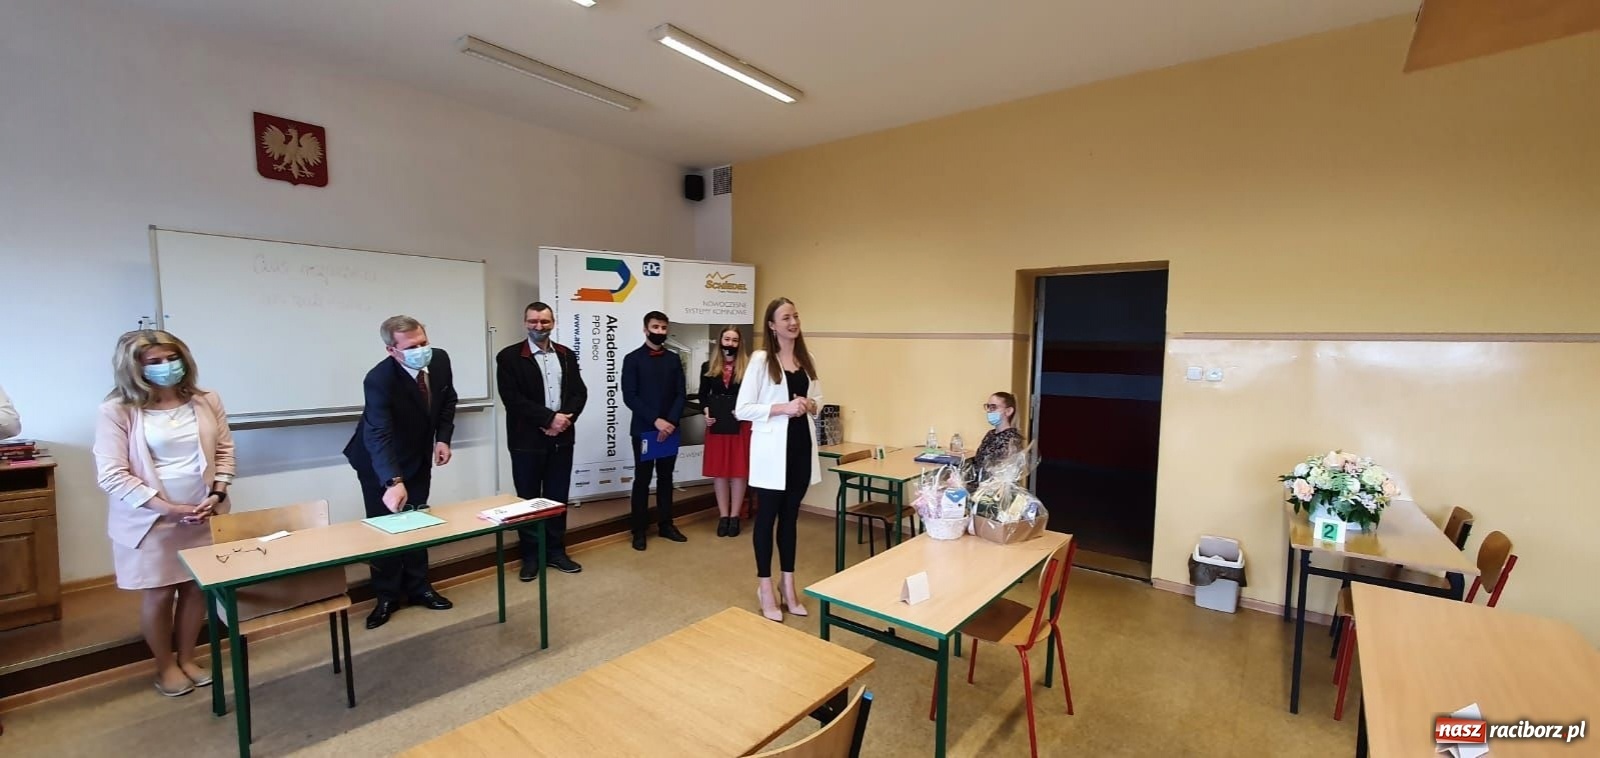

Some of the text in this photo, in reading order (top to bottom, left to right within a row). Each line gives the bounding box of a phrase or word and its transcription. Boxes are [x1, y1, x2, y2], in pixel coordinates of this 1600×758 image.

[642, 262, 660, 276] PPG
[702, 300, 747, 308] NOWOCZESNE
[684, 307, 748, 316] SYSTEMY KOMINOWE
[592, 315, 600, 361] PPG Deco
[1323, 524, 1335, 539] 2
